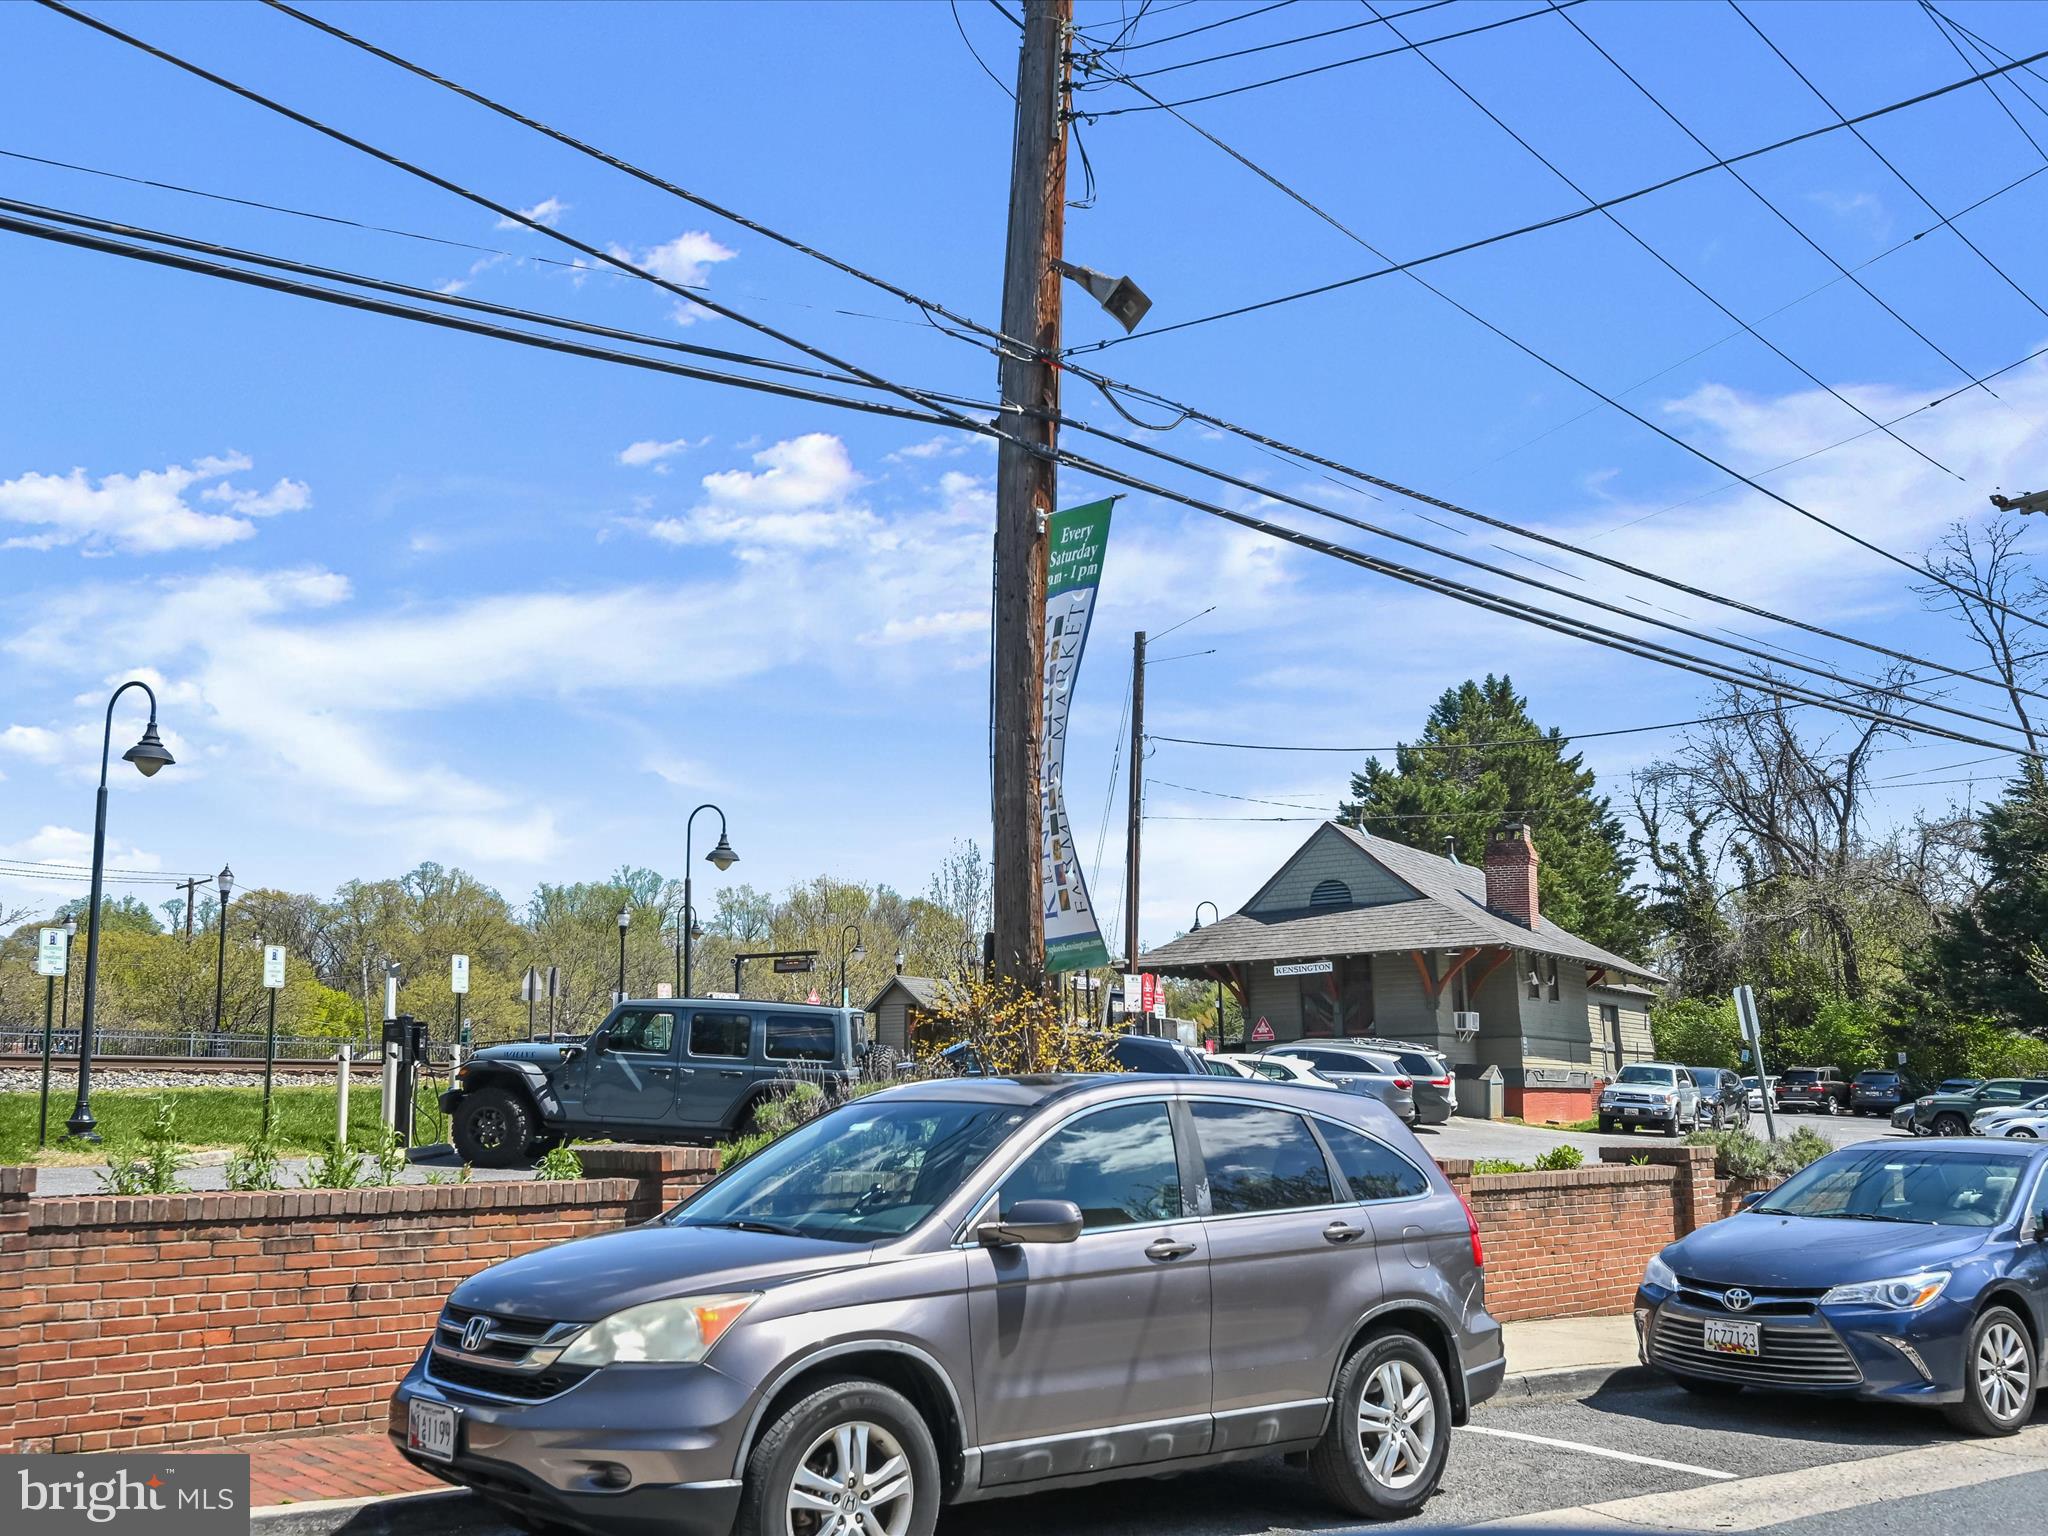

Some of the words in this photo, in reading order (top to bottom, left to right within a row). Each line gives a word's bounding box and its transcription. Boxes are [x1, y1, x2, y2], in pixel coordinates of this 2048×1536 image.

[1060, 525, 1094, 543] Every
[1049, 543, 1099, 568] Saturday
[1051, 603, 1086, 740] MARKET
[1275, 963, 1332, 975] KENSINGTON
